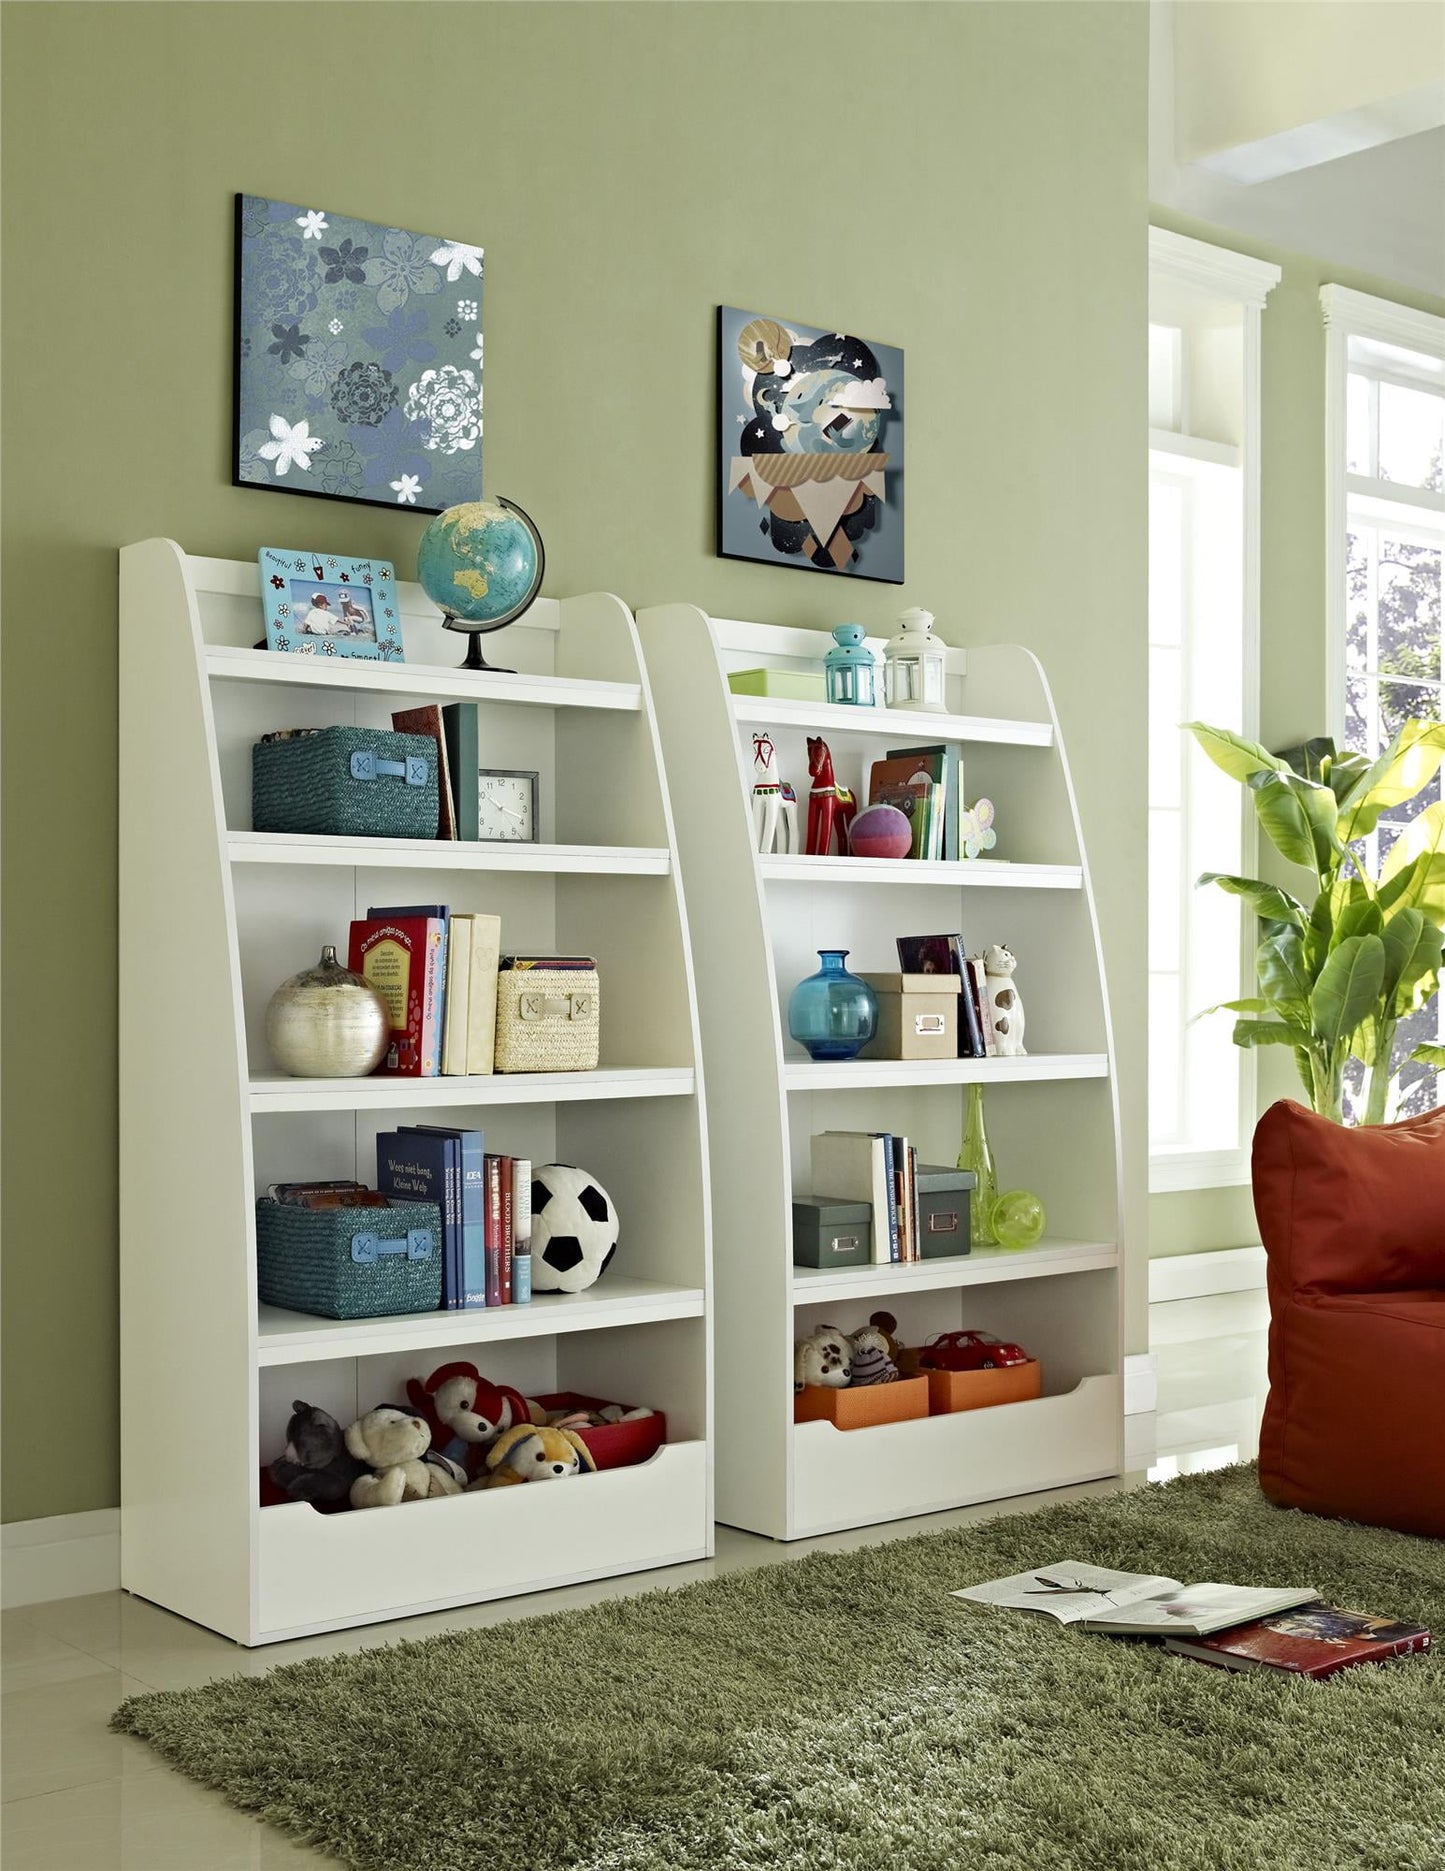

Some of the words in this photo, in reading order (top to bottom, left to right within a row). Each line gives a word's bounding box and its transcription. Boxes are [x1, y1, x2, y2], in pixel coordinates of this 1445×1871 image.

[351, 561, 372, 574] funny
[487, 782, 493, 790] 11
[428, 967, 434, 975] da
[388, 1160, 404, 1173] Wees
[405, 1163, 416, 1174] niet
[416, 1163, 432, 1179] bang,
[466, 1171, 481, 1180] IDEA
[393, 1176, 411, 1190] Kleine
[411, 1179, 427, 1195] Welp
[889, 1181, 897, 1225] PENDERWICKS
